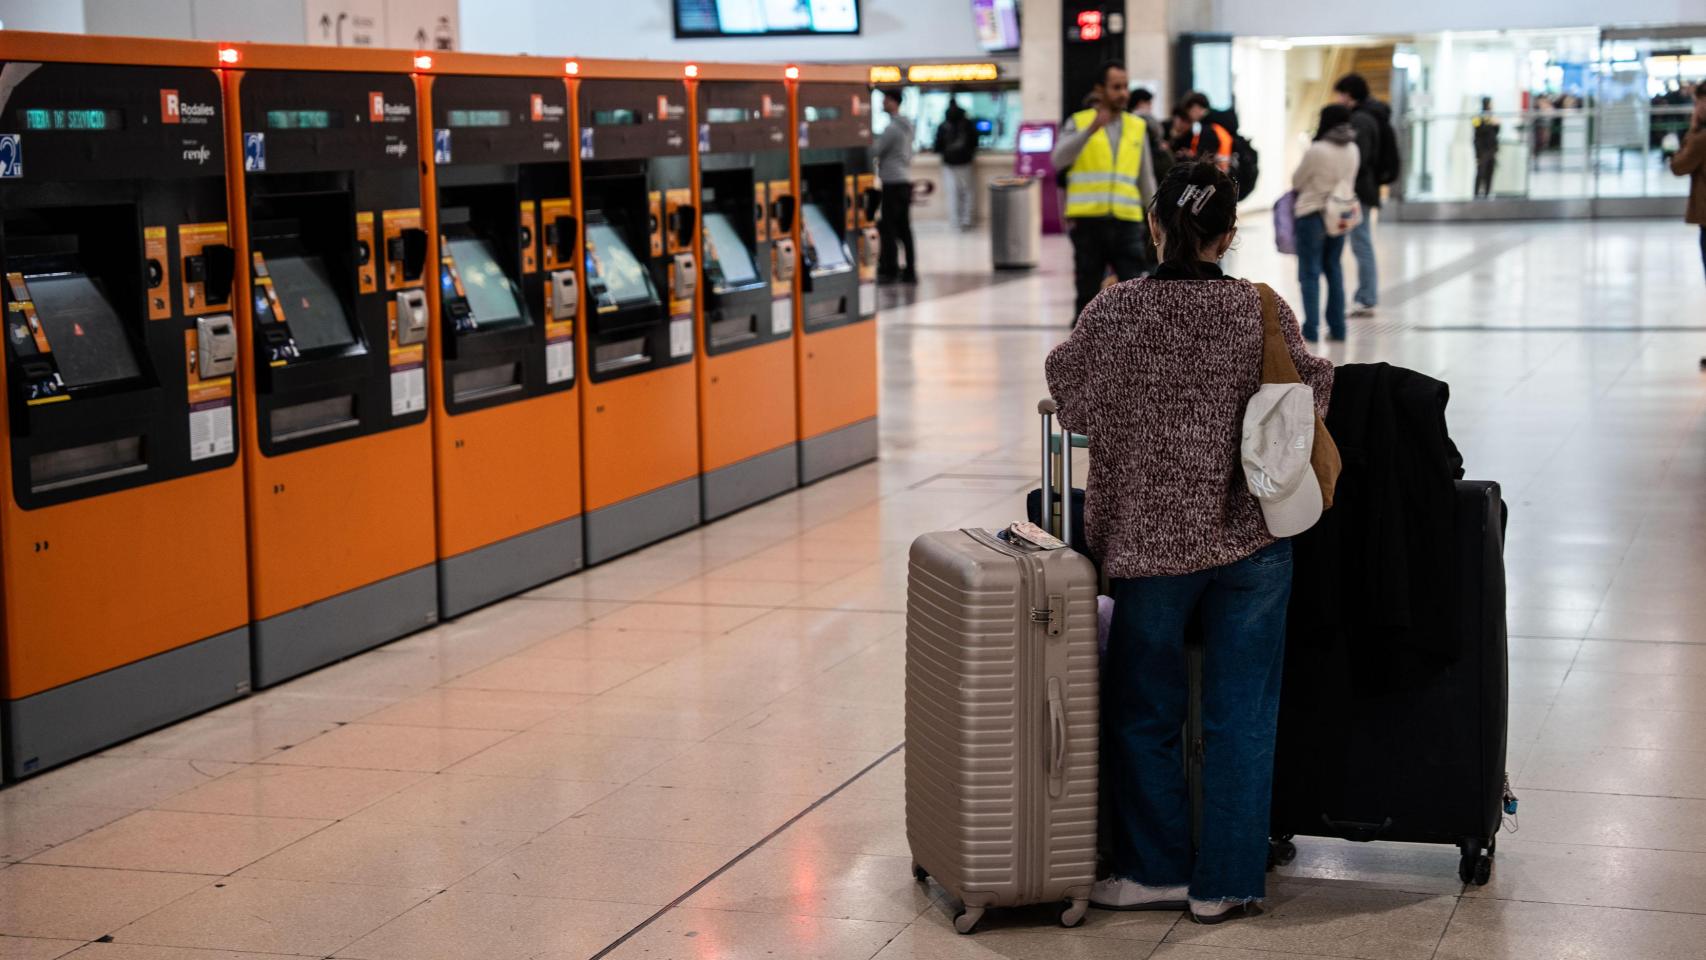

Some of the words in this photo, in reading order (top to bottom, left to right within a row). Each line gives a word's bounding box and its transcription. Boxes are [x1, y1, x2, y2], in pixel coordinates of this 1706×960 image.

[167, 94, 179, 116] R
[181, 103, 214, 116] Rodalies
[183, 144, 210, 165] renfe
